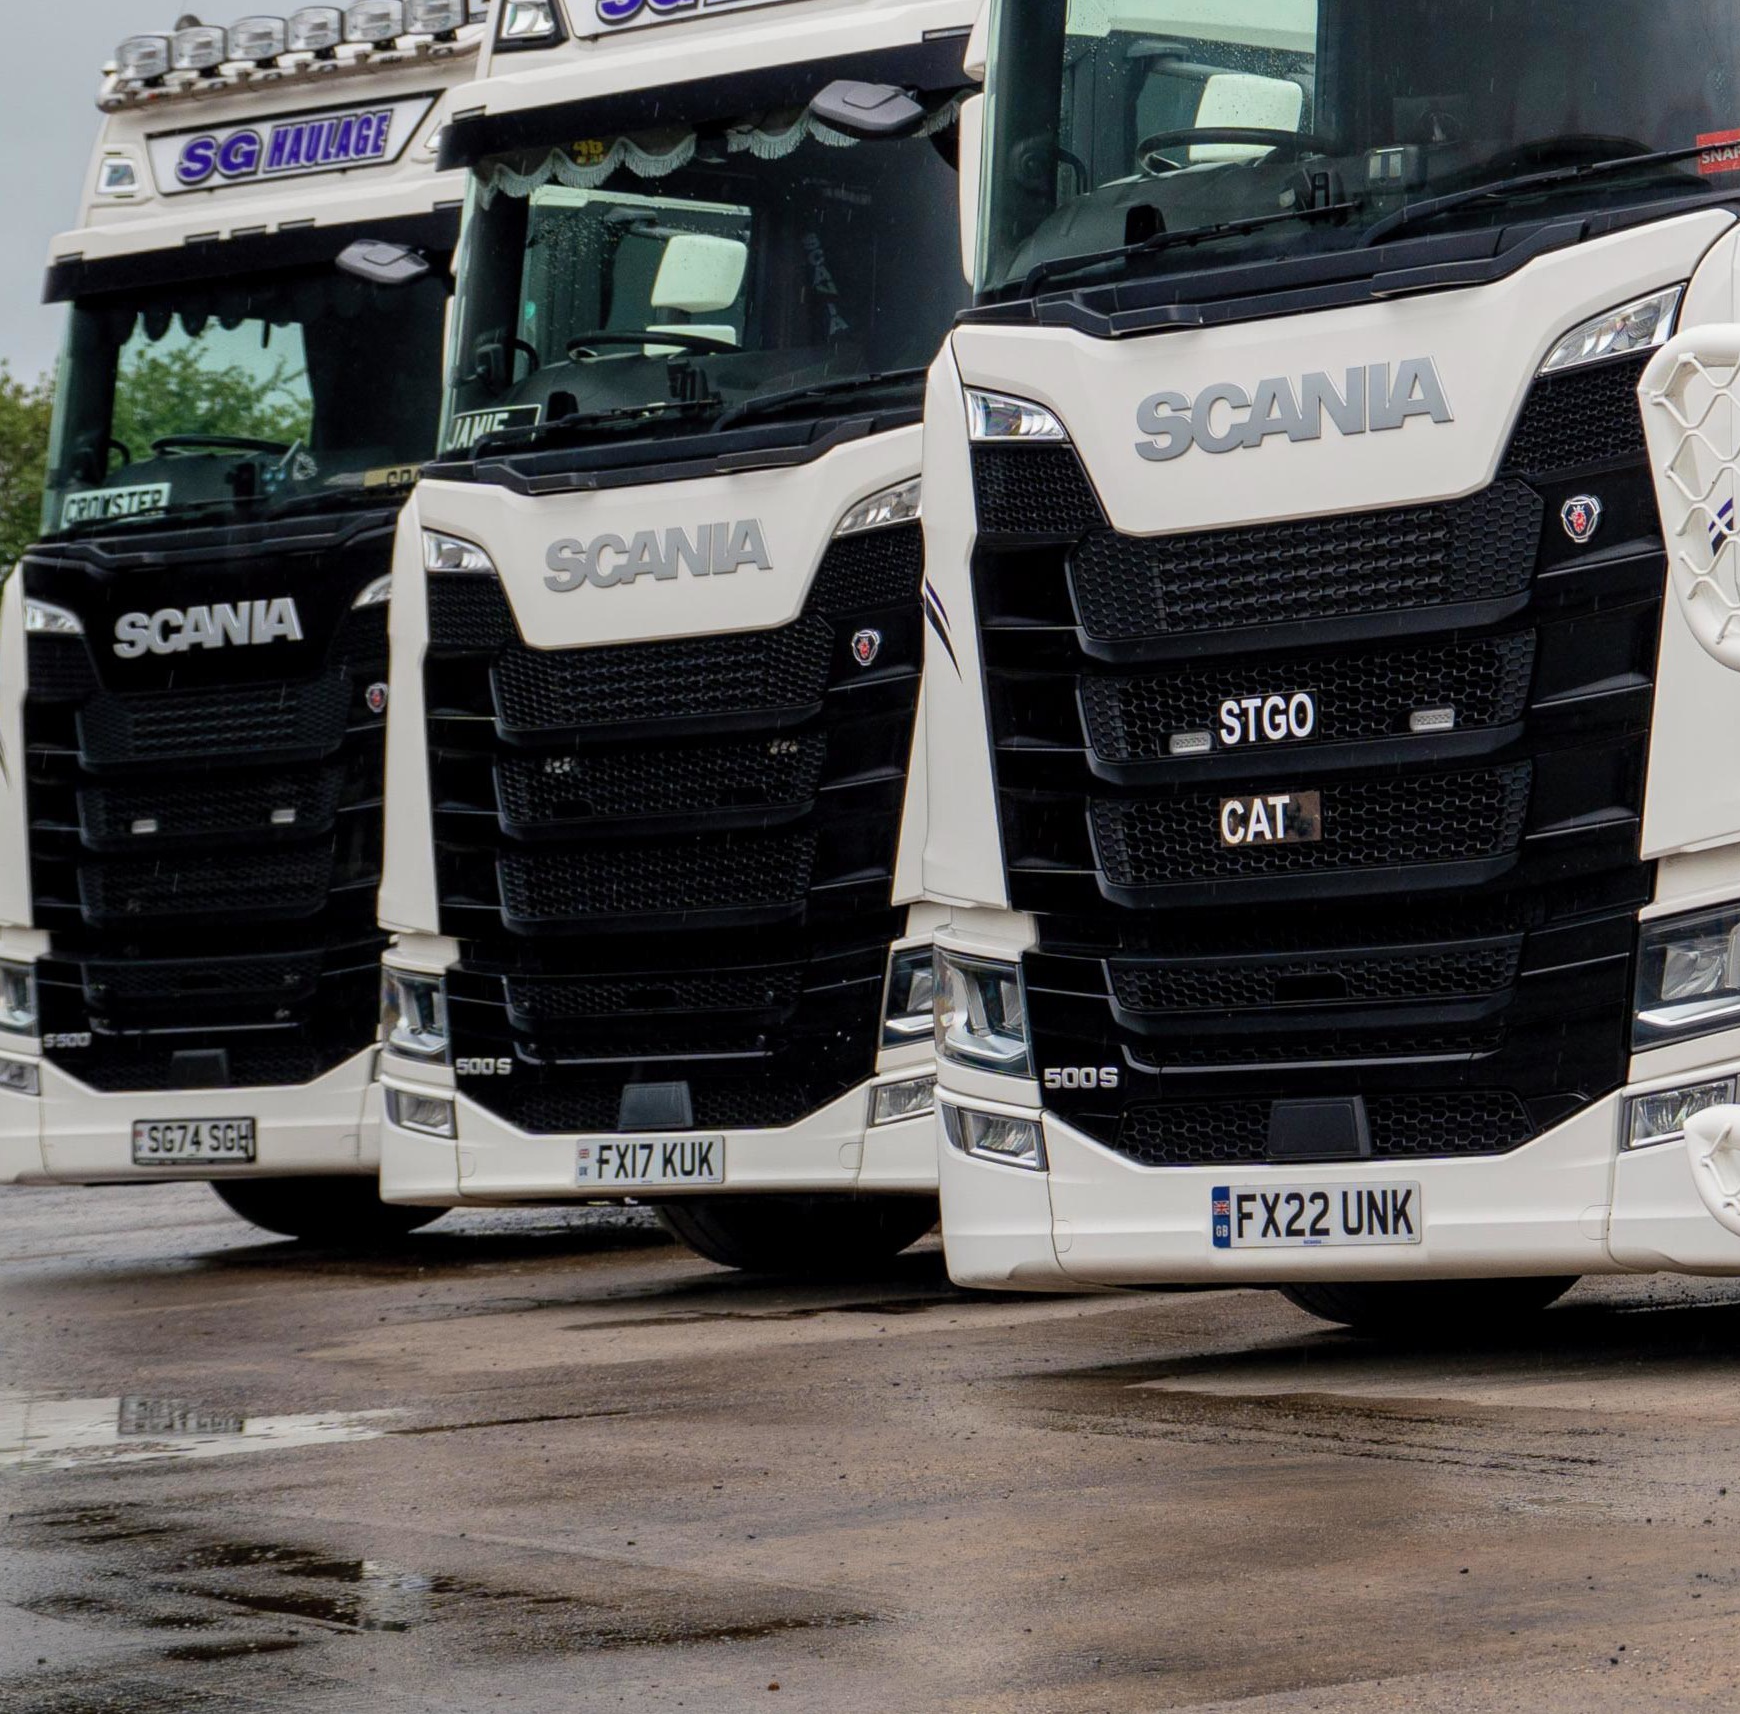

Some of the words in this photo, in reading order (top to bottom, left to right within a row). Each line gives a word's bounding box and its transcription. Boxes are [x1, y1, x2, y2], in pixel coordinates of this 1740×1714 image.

[177, 131, 261, 183] SG
[266, 110, 393, 171] HAULAGE
[446, 412, 510, 450] JAMIE
[1134, 356, 1455, 461] SCANIA
[544, 519, 773, 592] SCANIA
[113, 597, 303, 659] SCANIA
[1219, 694, 1316, 747] STGO
[1221, 796, 1290, 845] CAT
[1043, 1065, 1119, 1090] 500S
[148, 1124, 202, 1153] SG74
[596, 1143, 654, 1179] FX17
[662, 1141, 714, 1177] KUK
[1215, 1224, 1229, 1238] GB
[1236, 1191, 1330, 1238] FX22
[1342, 1188, 1414, 1236] UNK
